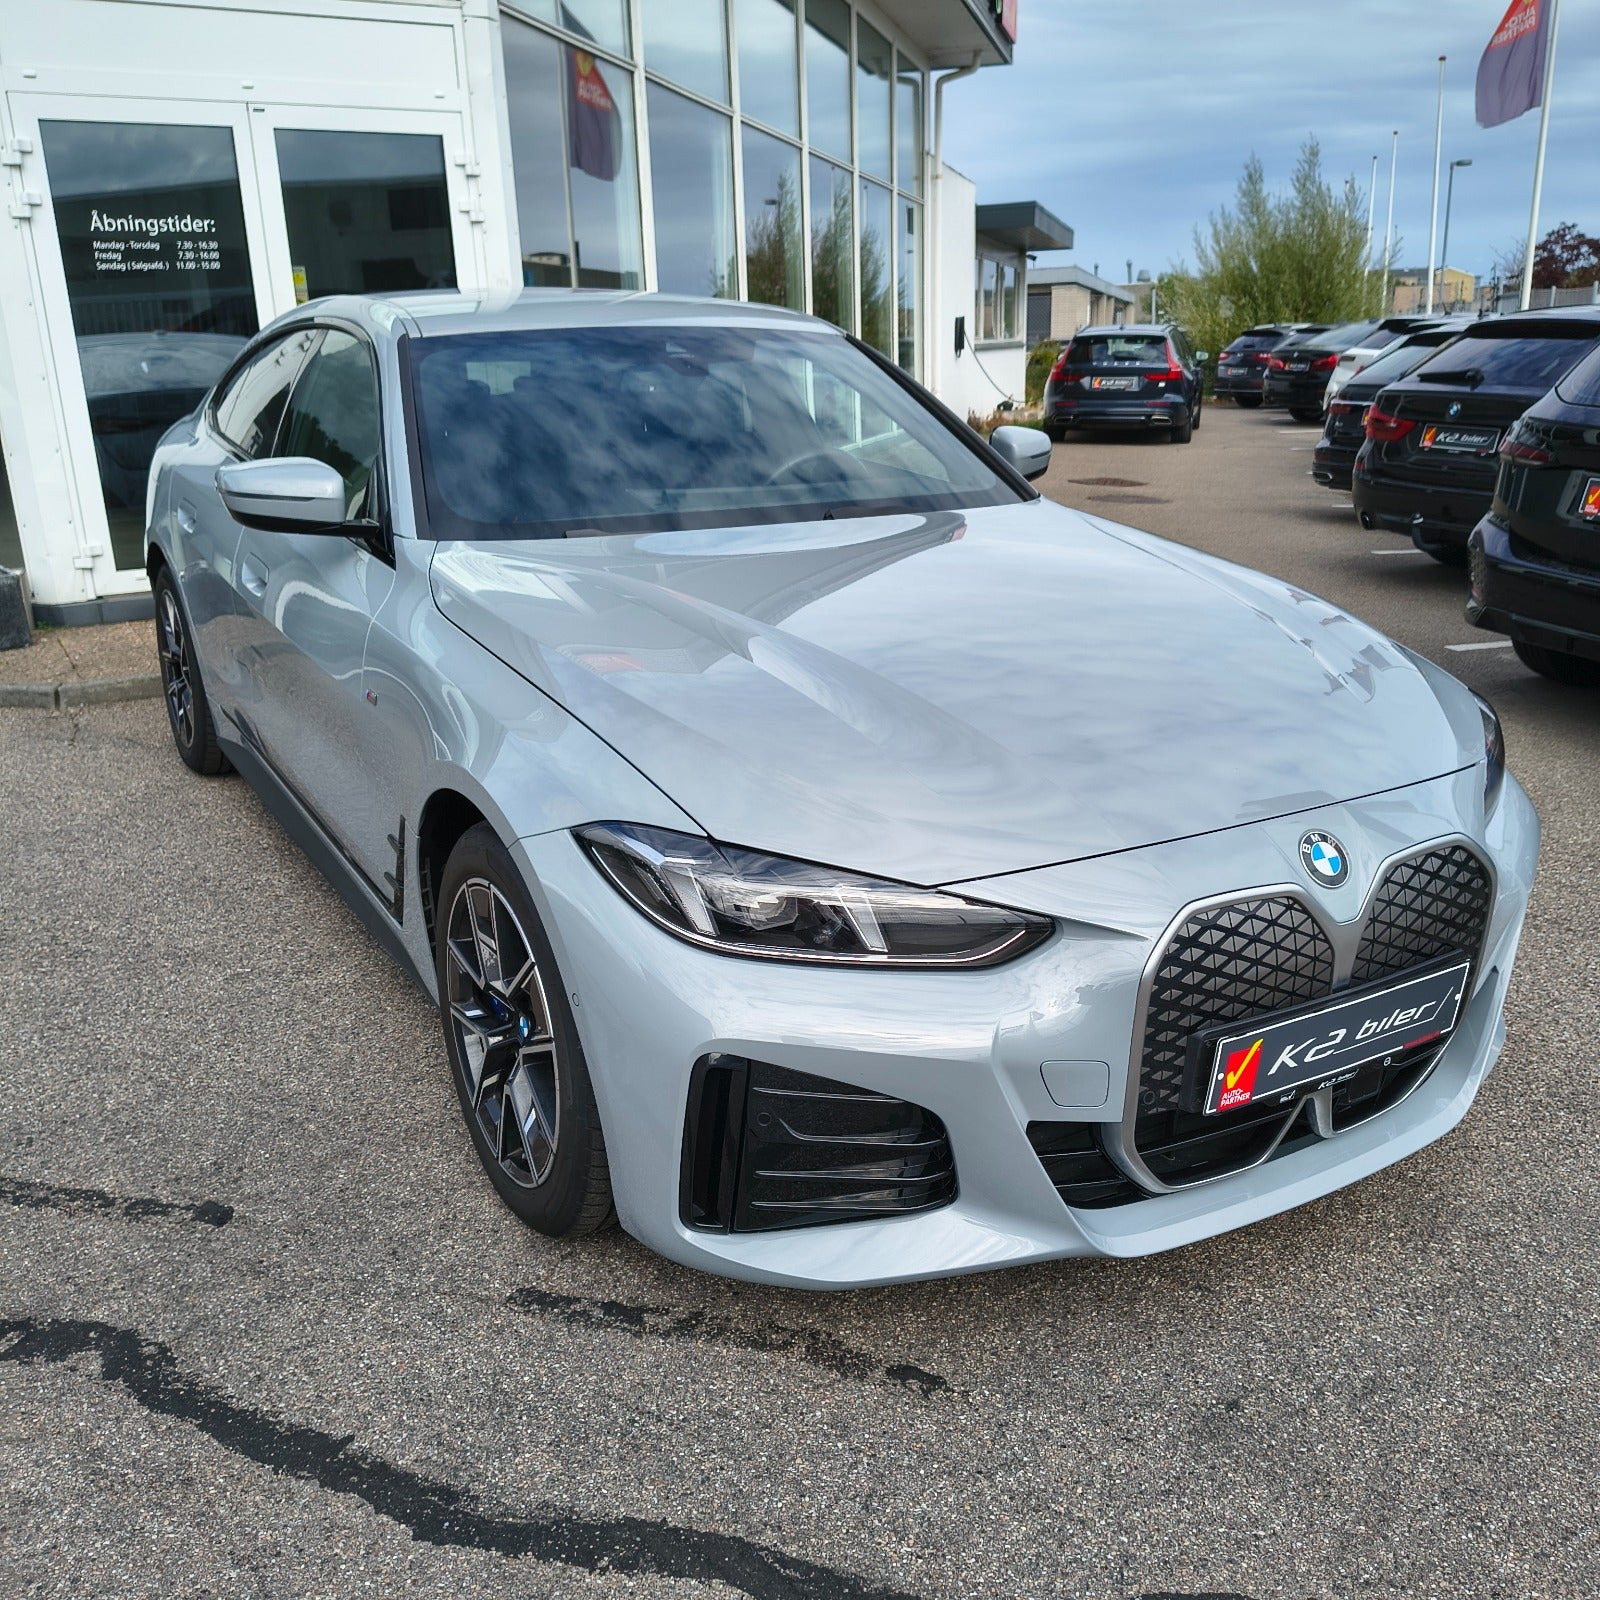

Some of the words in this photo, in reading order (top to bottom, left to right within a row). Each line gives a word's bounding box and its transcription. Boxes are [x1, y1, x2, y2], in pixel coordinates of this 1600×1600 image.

[90, 210, 216, 236] Åbningstider:
[93, 241, 125, 251] Mandag
[130, 241, 160, 251] Torsdag
[176, 241, 193, 249] 7.30
[95, 251, 122, 261] Fredag
[178, 251, 195, 259] 7.30
[1268, 1028, 1347, 1076] K2
[1355, 1000, 1437, 1040] biler
[1220, 1091, 1251, 1107] PARTNER
[1222, 1088, 1244, 1100] AUTO-
